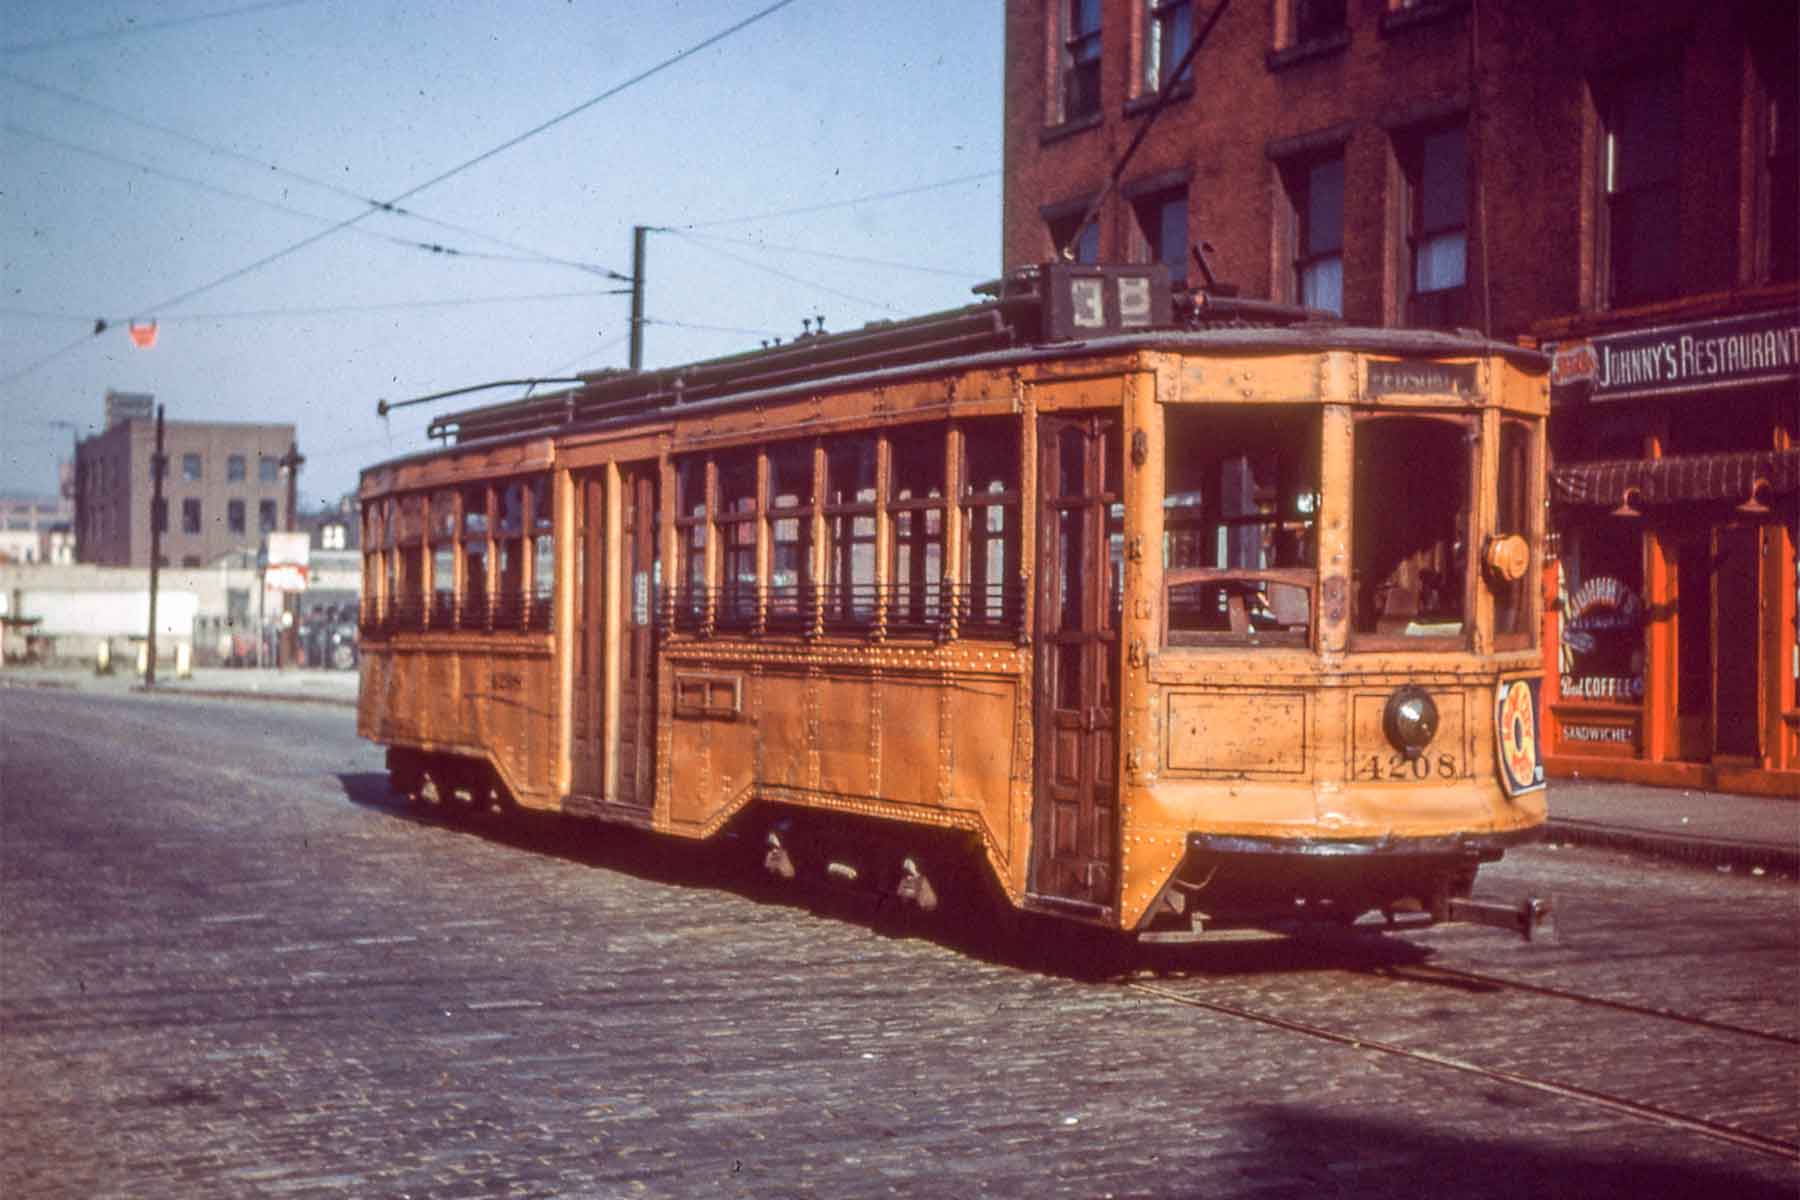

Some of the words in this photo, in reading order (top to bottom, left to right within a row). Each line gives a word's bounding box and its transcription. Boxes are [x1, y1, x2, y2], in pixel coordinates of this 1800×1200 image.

[1599, 342, 1677, 387] JOHNNY'S
[1680, 327, 1800, 378] RESTAURANT
[1357, 753, 1457, 780] 4208
